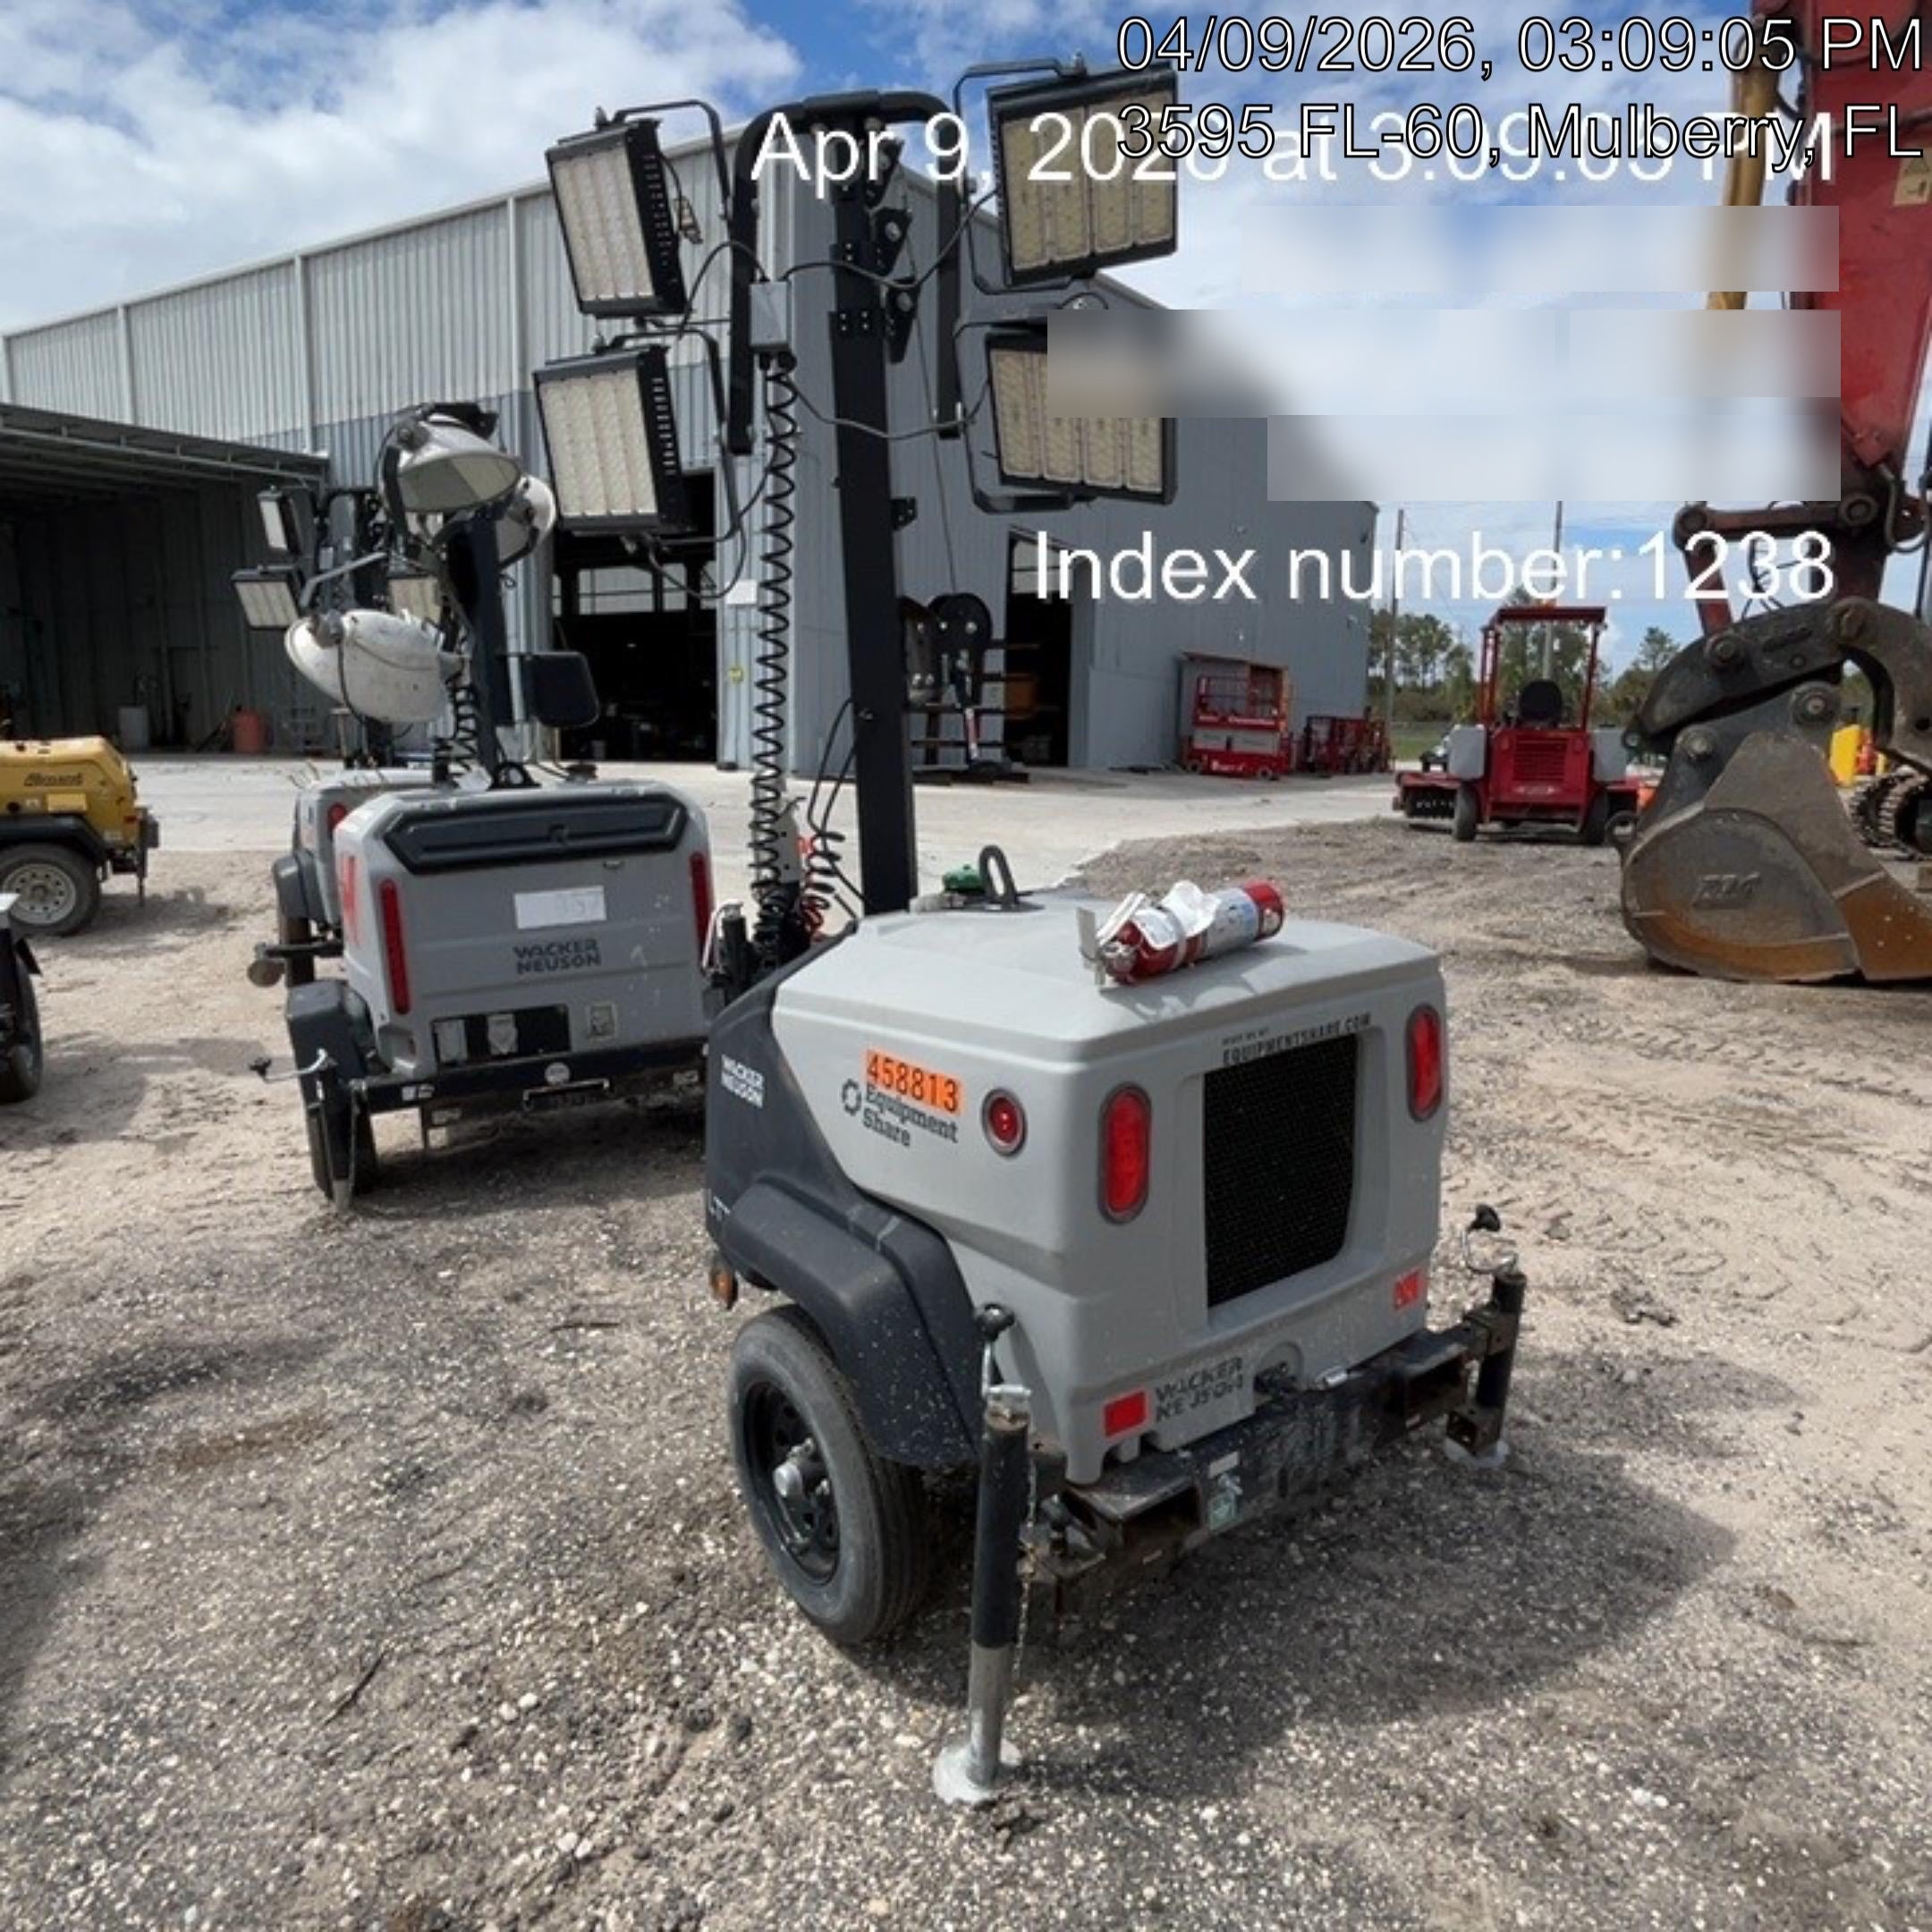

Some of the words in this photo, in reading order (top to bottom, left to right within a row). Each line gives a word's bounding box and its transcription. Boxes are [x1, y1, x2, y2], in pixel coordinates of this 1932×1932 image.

[513, 938, 600, 959] WACKER
[515, 953, 602, 974] NEUSON
[866, 1053, 959, 1114] 458813
[862, 1106, 911, 1147] Share
[865, 1082, 959, 1143] Equipment
